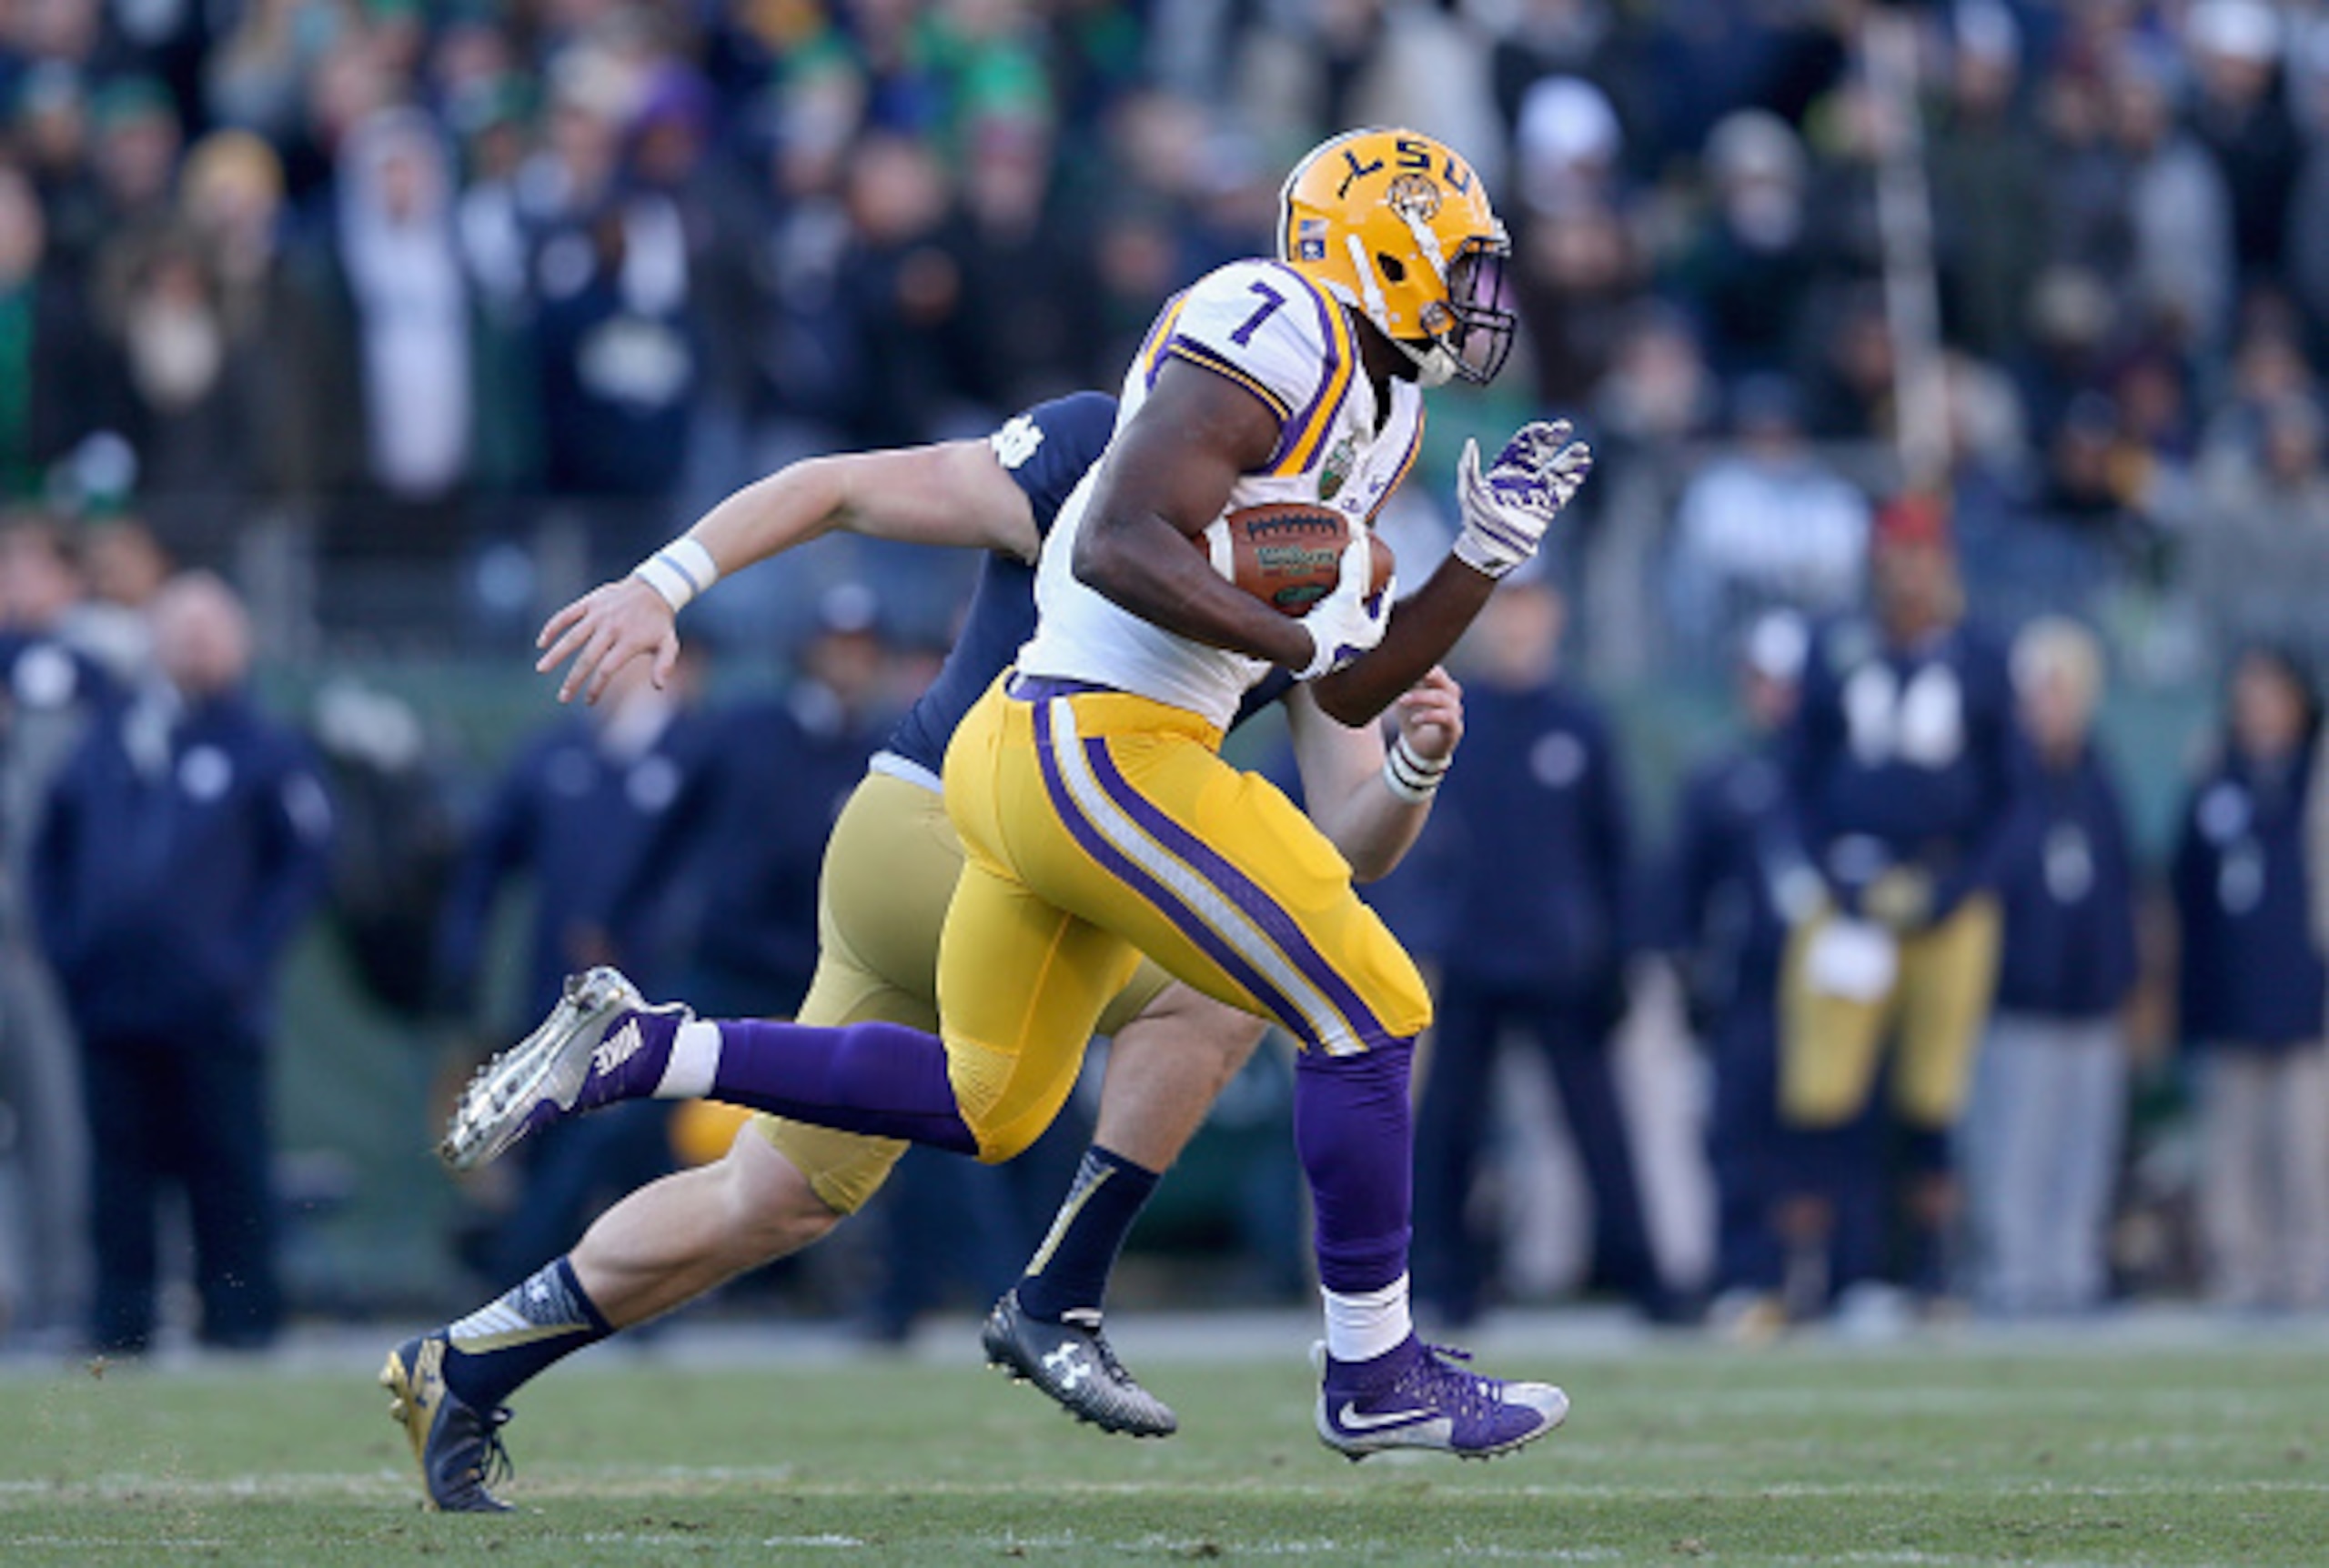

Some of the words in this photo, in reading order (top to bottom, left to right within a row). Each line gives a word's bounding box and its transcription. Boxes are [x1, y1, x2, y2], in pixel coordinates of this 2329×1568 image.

[1338, 139, 1470, 199] LSU
[1229, 281, 1286, 347] 7
[592, 1017, 642, 1076] NIKE
